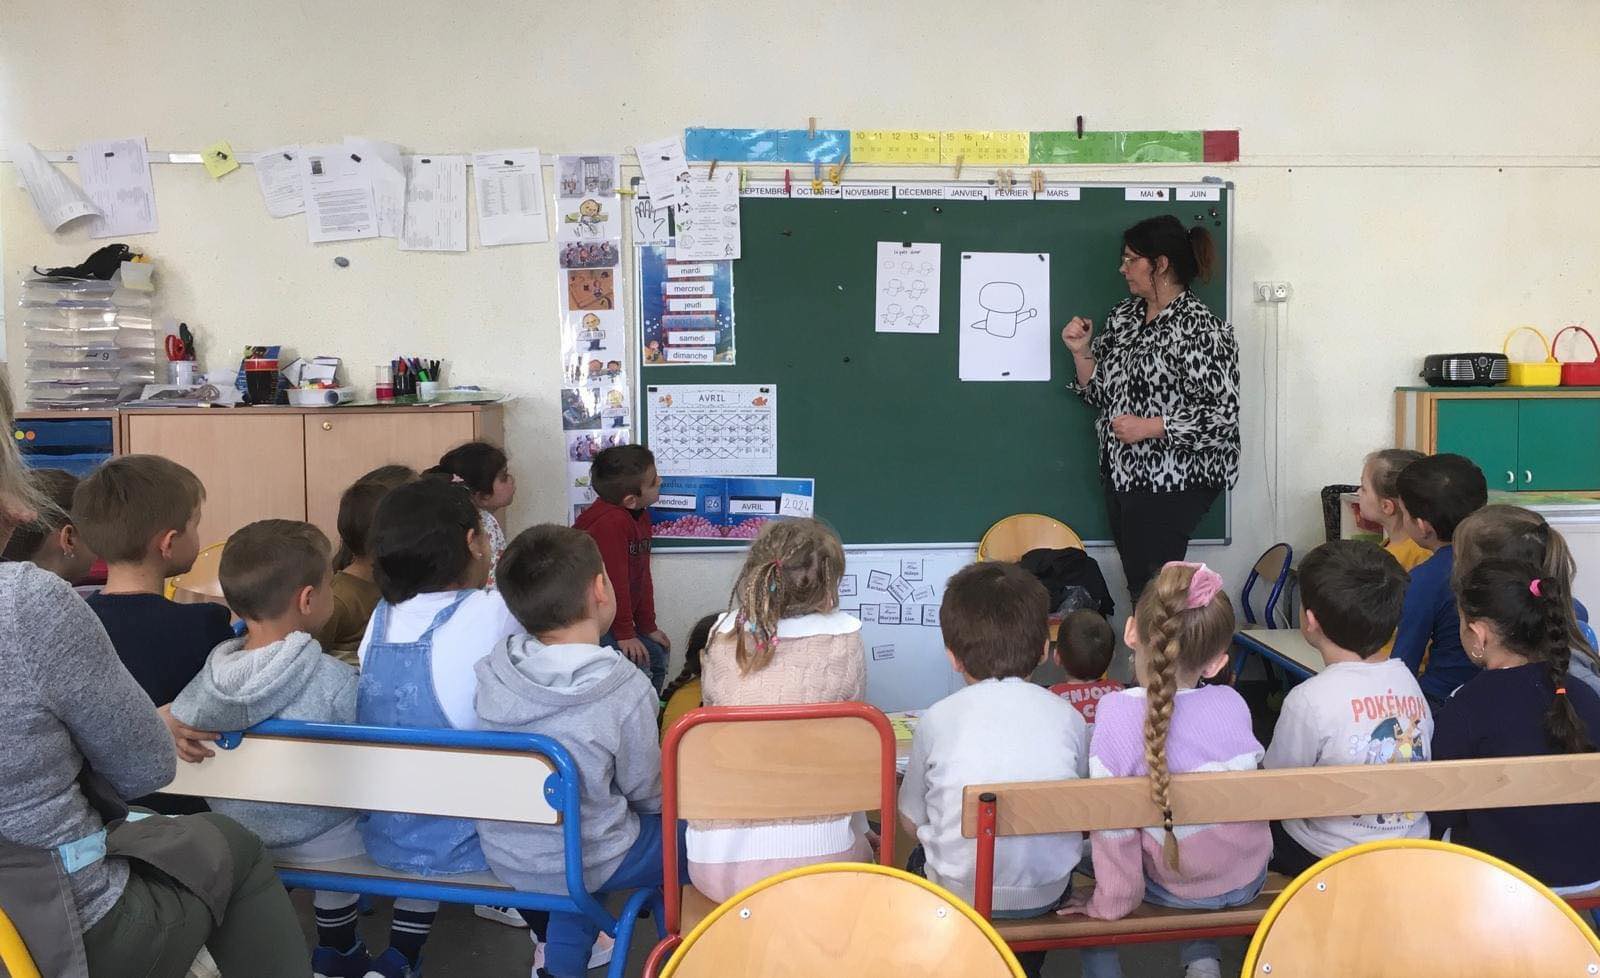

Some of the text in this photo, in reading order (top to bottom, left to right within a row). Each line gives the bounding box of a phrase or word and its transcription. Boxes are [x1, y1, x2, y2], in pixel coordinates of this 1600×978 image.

[856, 132, 865, 140] 10
[874, 132, 882, 140] 11
[892, 132, 901, 140] 12
[910, 132, 919, 141] 13
[964, 133, 973, 141] 16
[845, 188, 889, 197] NOVEMBRE
[899, 187, 942, 197] DÉCEMBRE
[950, 189, 983, 198] JANVIER
[1046, 189, 1069, 197] MARS
[1140, 190, 1154, 198] MAI
[1189, 189, 1206, 198] JUIN
[680, 267, 701, 275] mardi
[674, 284, 705, 292] mercredi
[684, 301, 702, 310] jeudi
[672, 351, 708, 360] dimanche
[706, 500, 719, 509] 26
[1351, 688, 1426, 722] POKÉMON
